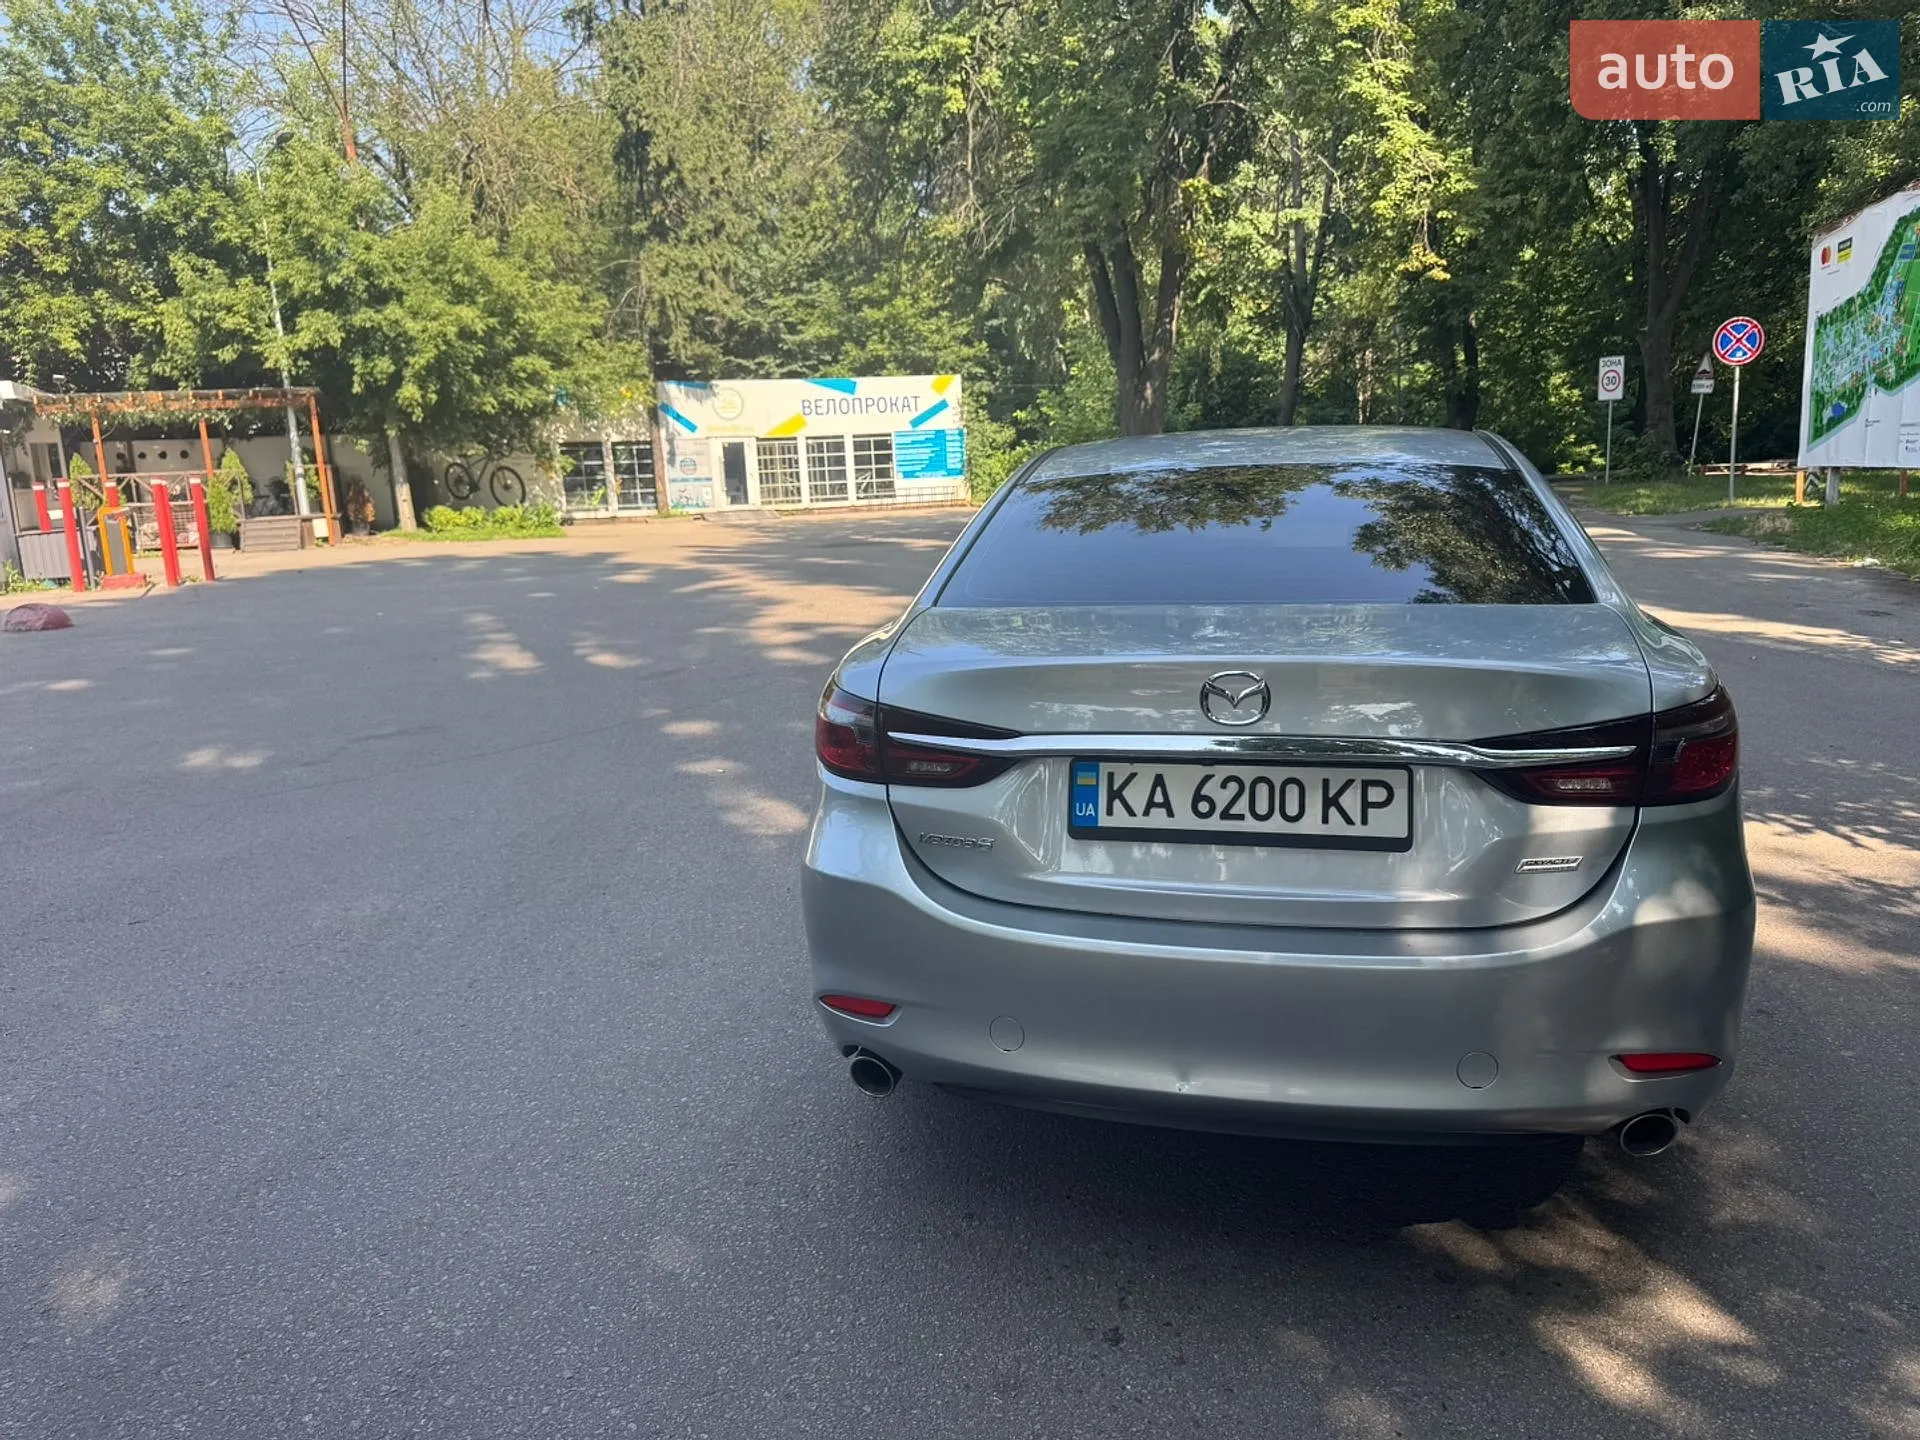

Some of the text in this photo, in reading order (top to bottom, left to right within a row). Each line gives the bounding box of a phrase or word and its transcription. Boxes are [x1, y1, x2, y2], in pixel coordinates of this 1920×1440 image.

[1601, 358, 1623, 369] ЗОНА
[1604, 375, 1618, 388] 30
[801, 395, 921, 417] ВЕЛОПРОКАТ
[1105, 770, 1396, 826] KA 6200 KP
[1075, 802, 1096, 817] UA
